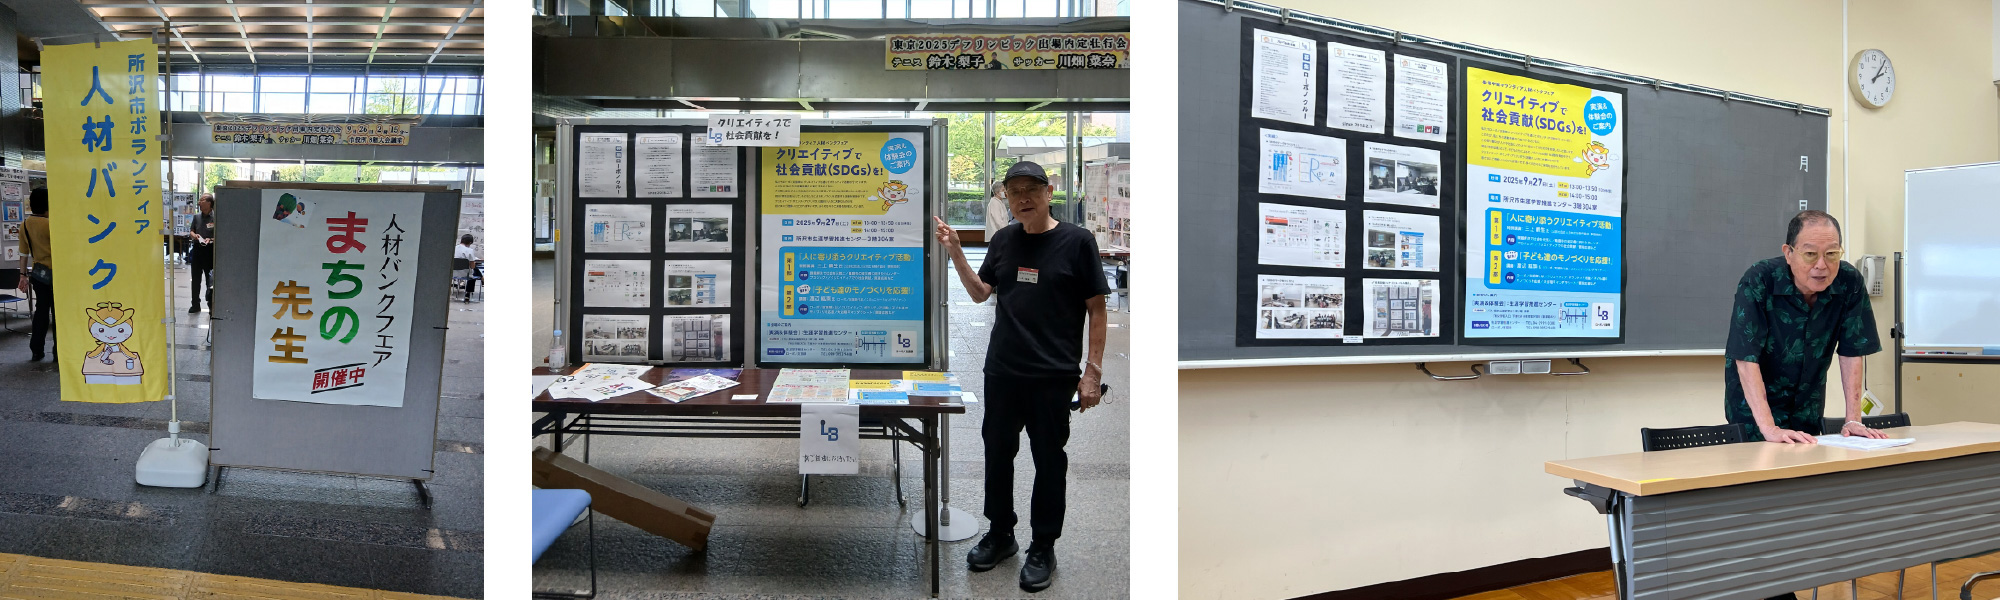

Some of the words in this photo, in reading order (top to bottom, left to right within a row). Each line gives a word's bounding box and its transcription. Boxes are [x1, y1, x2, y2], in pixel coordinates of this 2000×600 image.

[892, 38, 1128, 51] 東京2025デフリンピック出場内定壮行会
[892, 57, 923, 67] テニス
[927, 54, 955, 68] 鈴木
[1013, 58, 1055, 68] サッカー
[1058, 54, 1084, 68] 川畑
[1481, 89, 1568, 116] クリエイティブで
[717, 118, 792, 128] クリエイティブで
[1588, 112, 1612, 121] 体験会の
[1592, 122, 1612, 130] ご案内
[128, 53, 150, 234] 所沢市ボランティア
[776, 148, 862, 161] クリエイティブで
[1800, 155, 1809, 173] 月
[81, 65, 118, 290] 人材バンク
[1799, 199, 1808, 211] 日
[319, 211, 369, 344] まちの
[372, 213, 405, 368] 人材バンクフェア
[268, 279, 314, 364] 先生
[312, 367, 366, 390] 開催中
